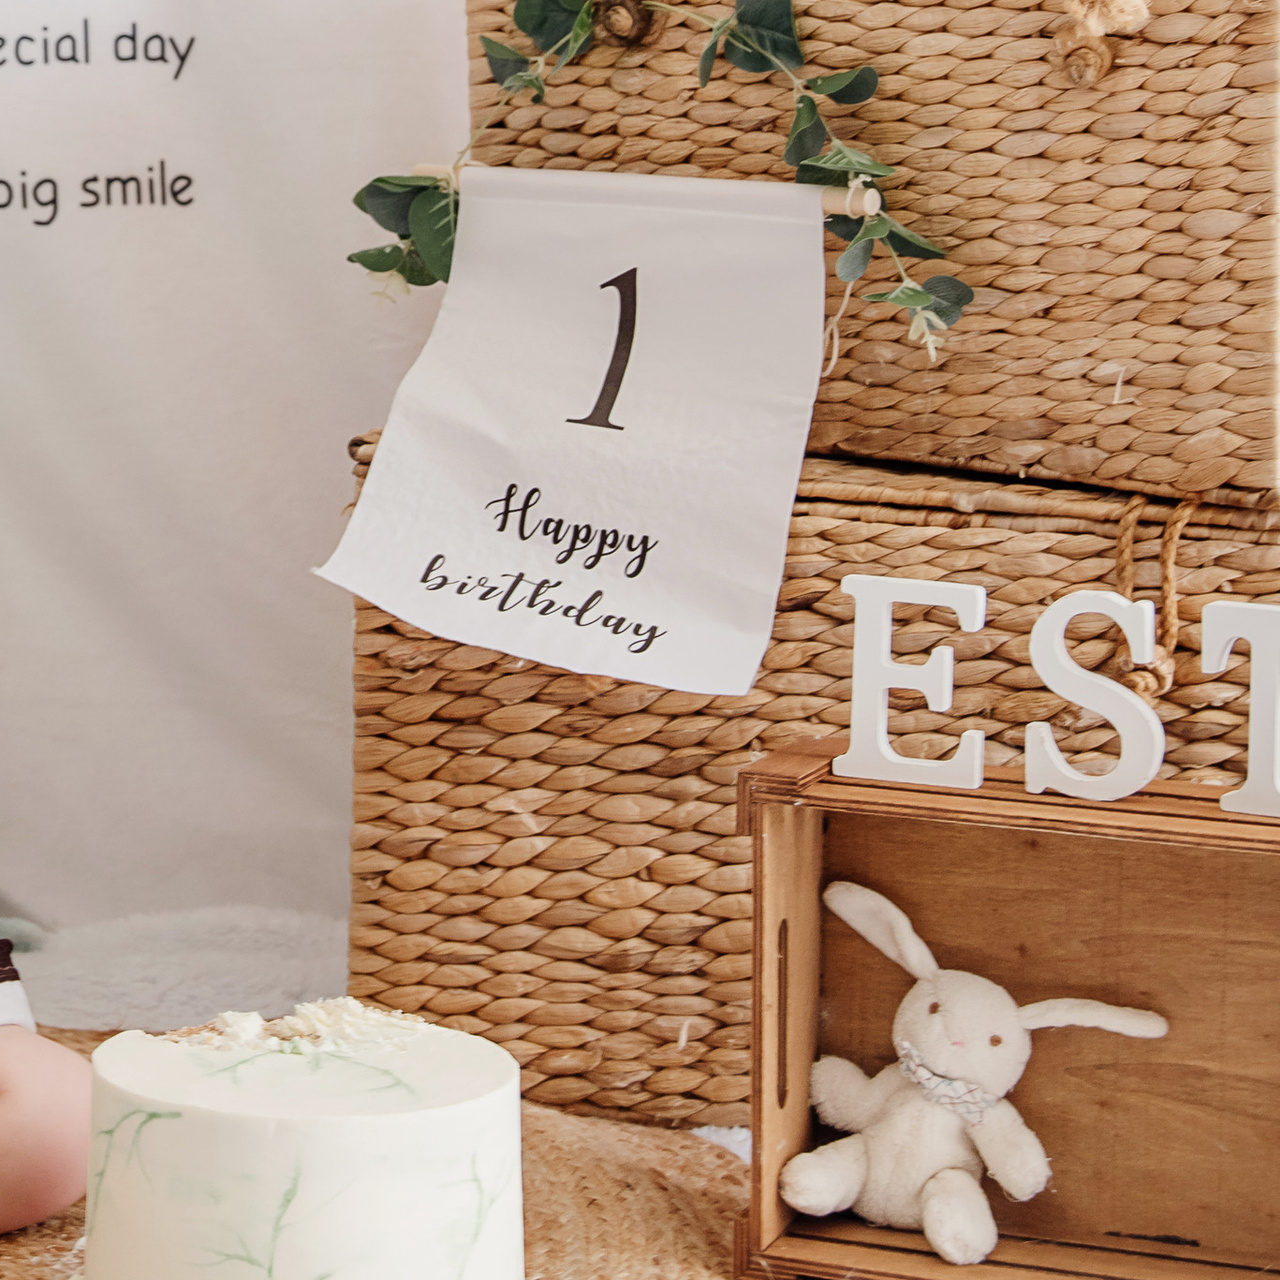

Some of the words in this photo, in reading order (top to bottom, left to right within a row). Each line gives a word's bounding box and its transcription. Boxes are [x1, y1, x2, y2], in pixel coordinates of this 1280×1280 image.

[113, 22, 196, 80] day
[79, 159, 195, 209] smile
[565, 267, 638, 431] 1
[485, 483, 659, 579] Happy
[419, 553, 668, 654] birthday
